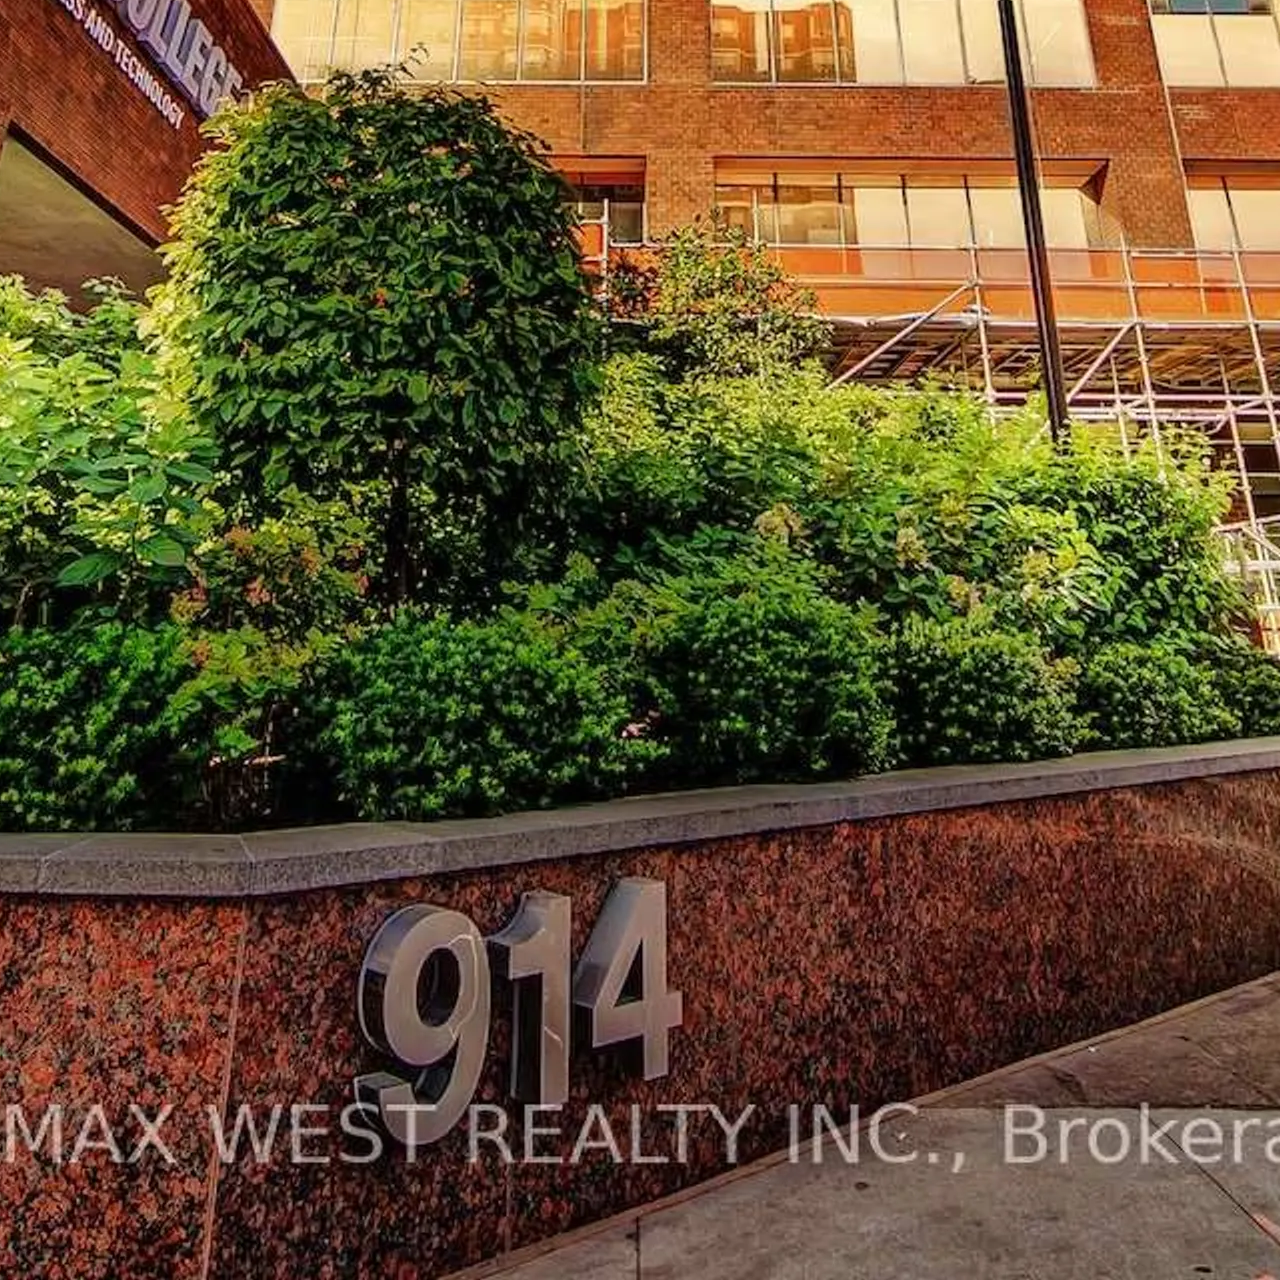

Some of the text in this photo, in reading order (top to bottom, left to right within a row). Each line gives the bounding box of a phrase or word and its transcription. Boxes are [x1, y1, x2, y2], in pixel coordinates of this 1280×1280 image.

[84, 9, 115, 52] AND
[113, 39, 185, 130] TECHNOLOGY
[354, 876, 683, 1145] 914
